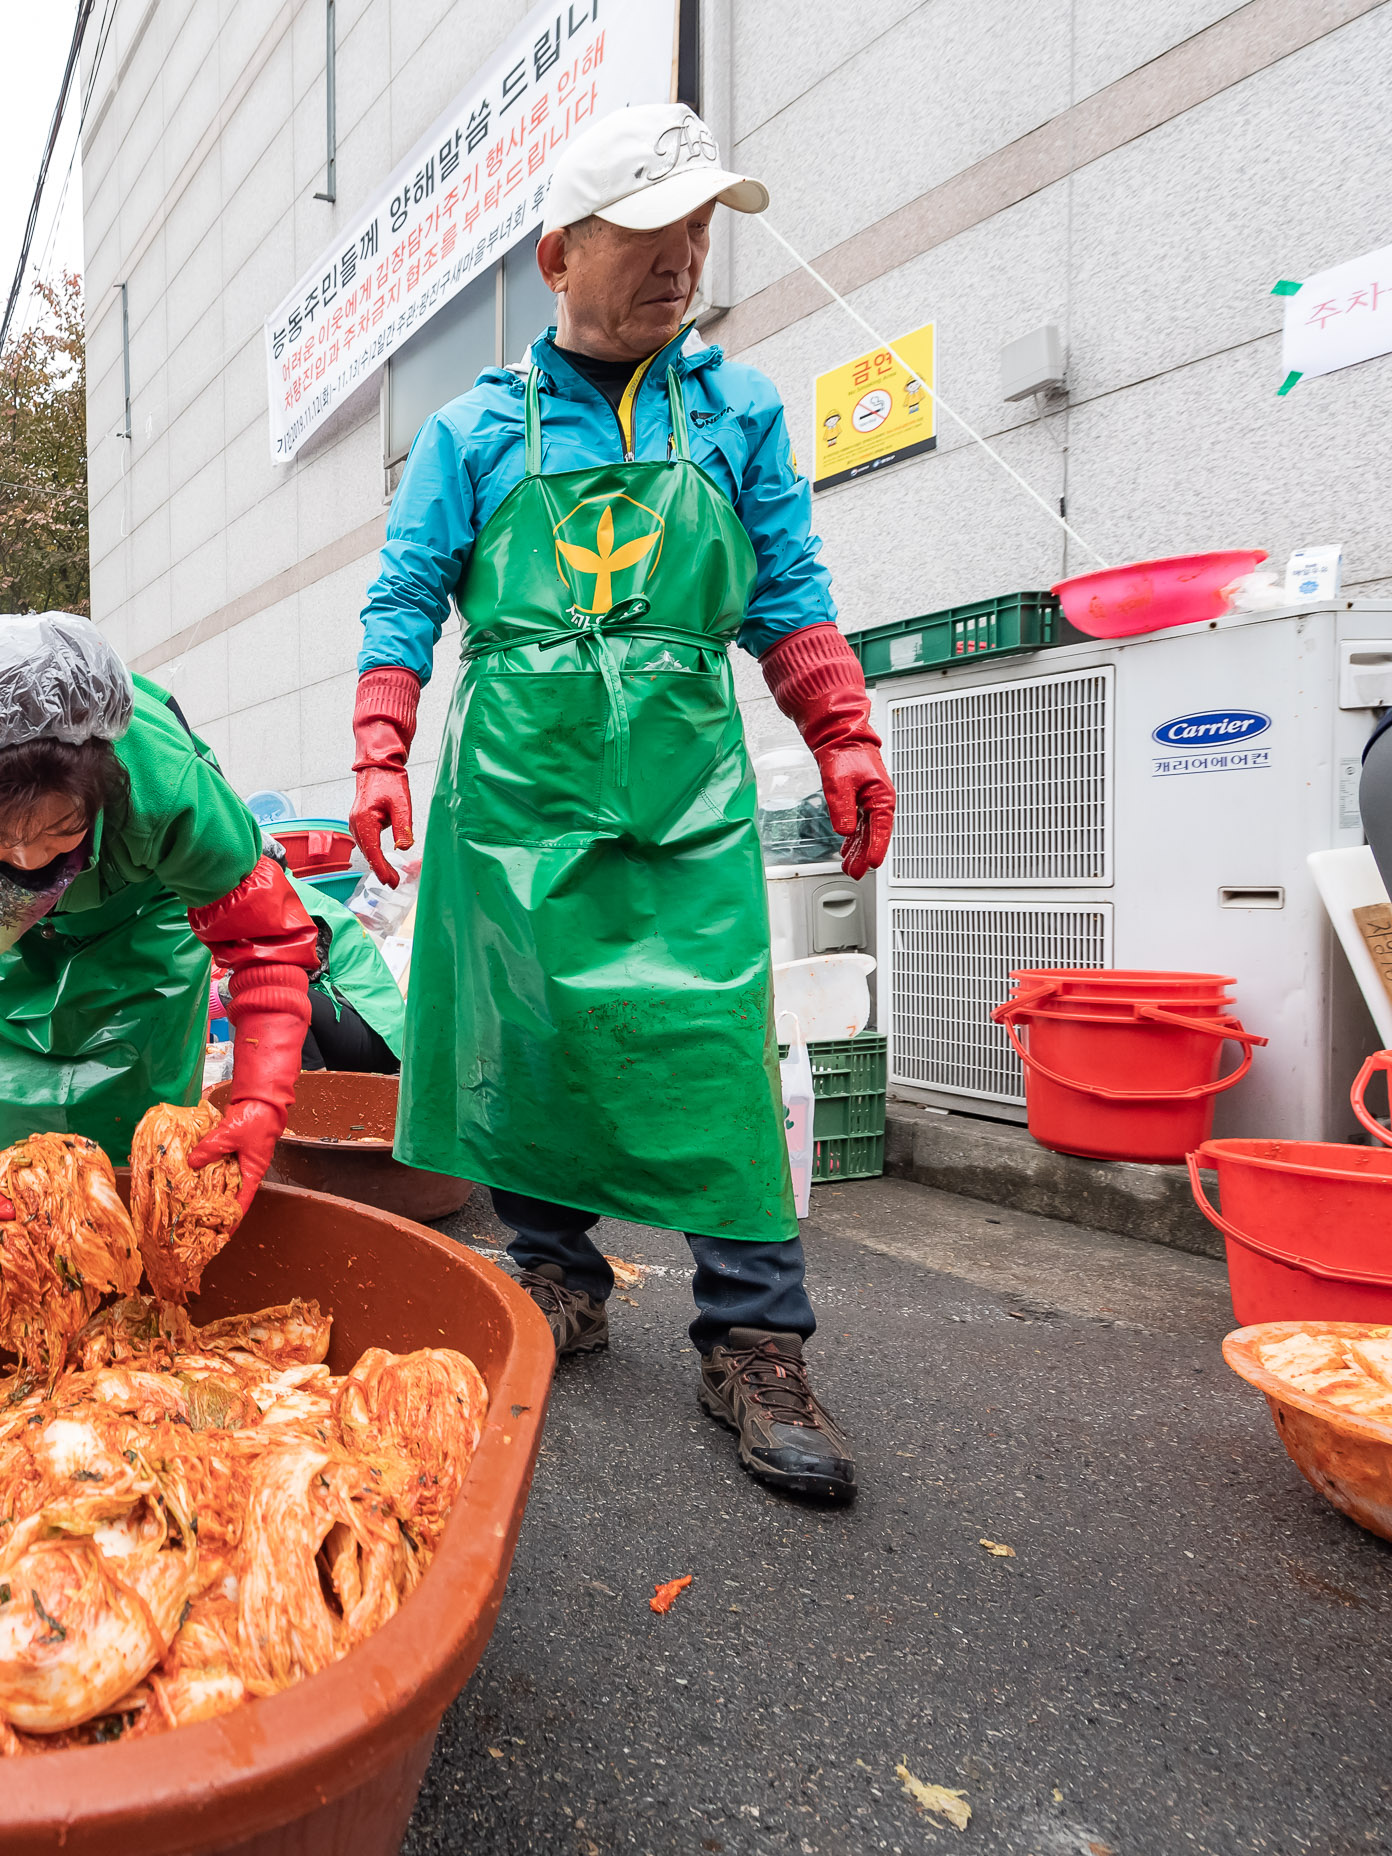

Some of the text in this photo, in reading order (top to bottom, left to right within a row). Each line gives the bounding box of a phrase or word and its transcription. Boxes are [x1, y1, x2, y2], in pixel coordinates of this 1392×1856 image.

[282, 29, 606, 382] 어려운 이웃에게 김장담가주기 행사로 인해
[284, 80, 598, 411] 차량진입과 주차금지 협조를 부탁드립니다
[272, 218, 379, 359] 능동주민들께
[1305, 281, 1392, 329] 주차
[852, 354, 892, 386] 금연
[1167, 718, 1256, 740] Carrier
[1154, 752, 1269, 773] 캐리어에어컨
